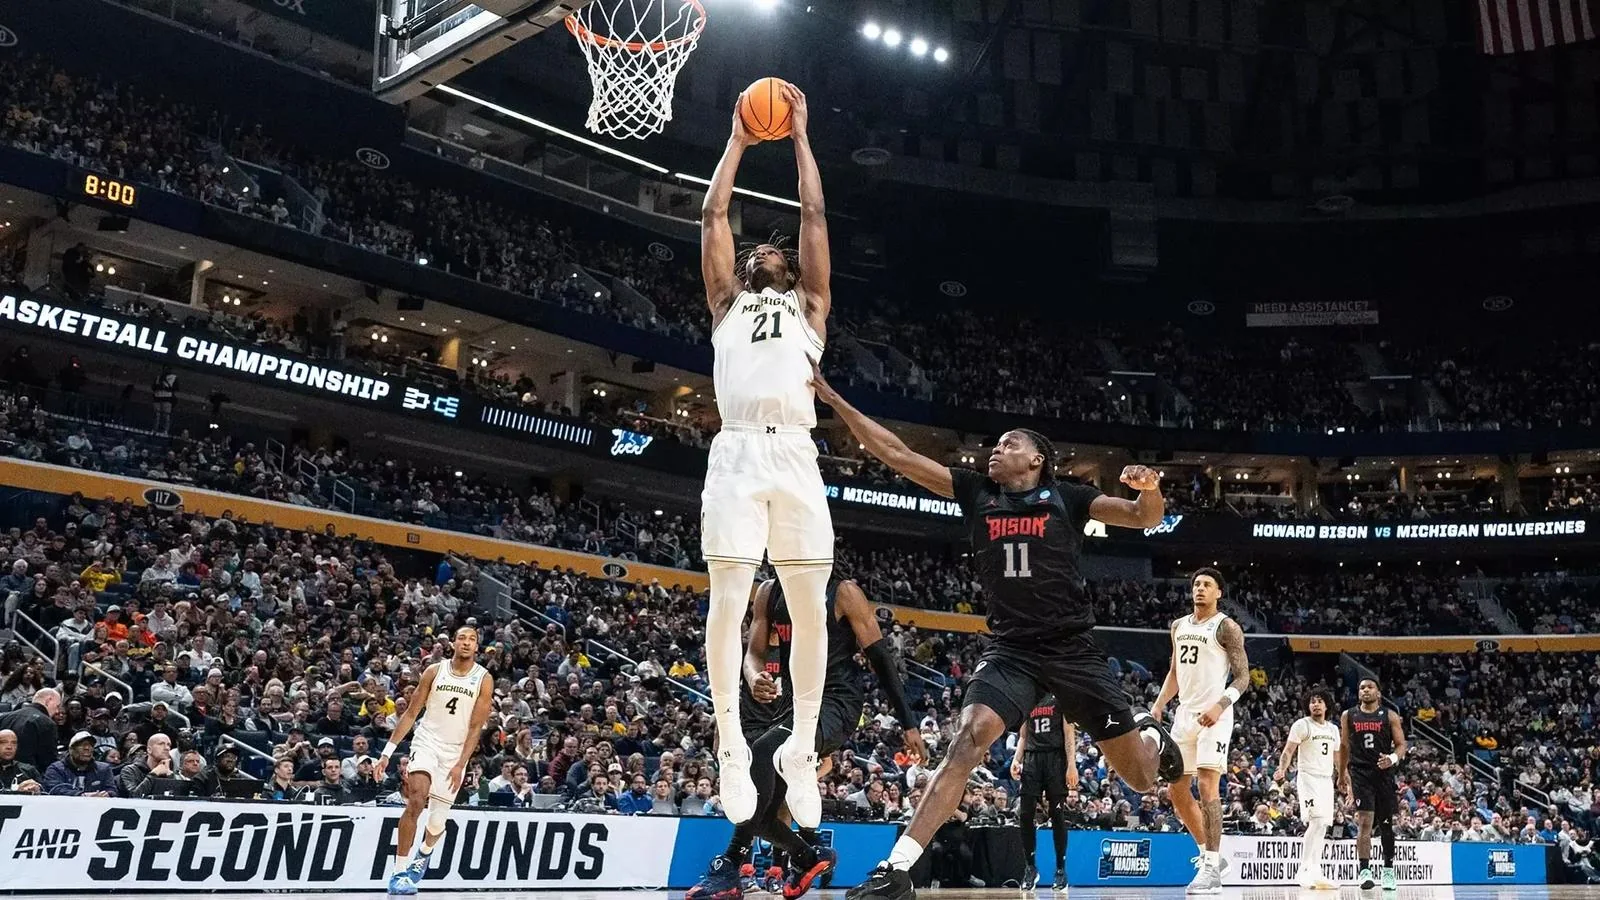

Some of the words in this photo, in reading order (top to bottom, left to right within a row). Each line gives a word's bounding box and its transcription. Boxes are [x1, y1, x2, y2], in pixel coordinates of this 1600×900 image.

[365, 151, 380, 165] 321
[85, 174, 135, 205] 8:00
[1255, 303, 1287, 313] NEED
[751, 311, 783, 343] 21
[0, 295, 168, 353] ASKETBALL
[177, 336, 390, 400] CHAMPIONSHIP
[766, 426, 776, 434] M
[155, 491, 170, 504] 117
[843, 487, 917, 510] MICHIGAN
[919, 499, 963, 517] WOLVE
[985, 512, 1050, 541] BISON
[1253, 524, 1316, 538] HOWARD
[1319, 525, 1368, 539] BISON
[1375, 527, 1391, 538] VS
[1396, 524, 1479, 538] MICHIGAN
[1483, 520, 1586, 537] WOLVERINES
[1003, 543, 1032, 577] 11
[1177, 634, 1208, 644] MICHIGAN
[1180, 645, 1199, 664] 23
[436, 684, 474, 698] MICHIGAN
[446, 697, 459, 715] 4
[1034, 717, 1051, 734] 12
[1353, 721, 1383, 732] BISON
[1216, 741, 1226, 754] M
[1364, 733, 1374, 748] 2
[1322, 743, 1329, 755] 3
[1305, 799, 1314, 807] M
[12, 829, 81, 859] AND
[87, 807, 354, 882] SECOND
[1111, 843, 1138, 857] MARCH
[1257, 841, 1288, 859] METRO
[1114, 857, 1150, 872] MADNESS
[1241, 862, 1284, 880] CANISIUS
[1338, 864, 1354, 880] AND
